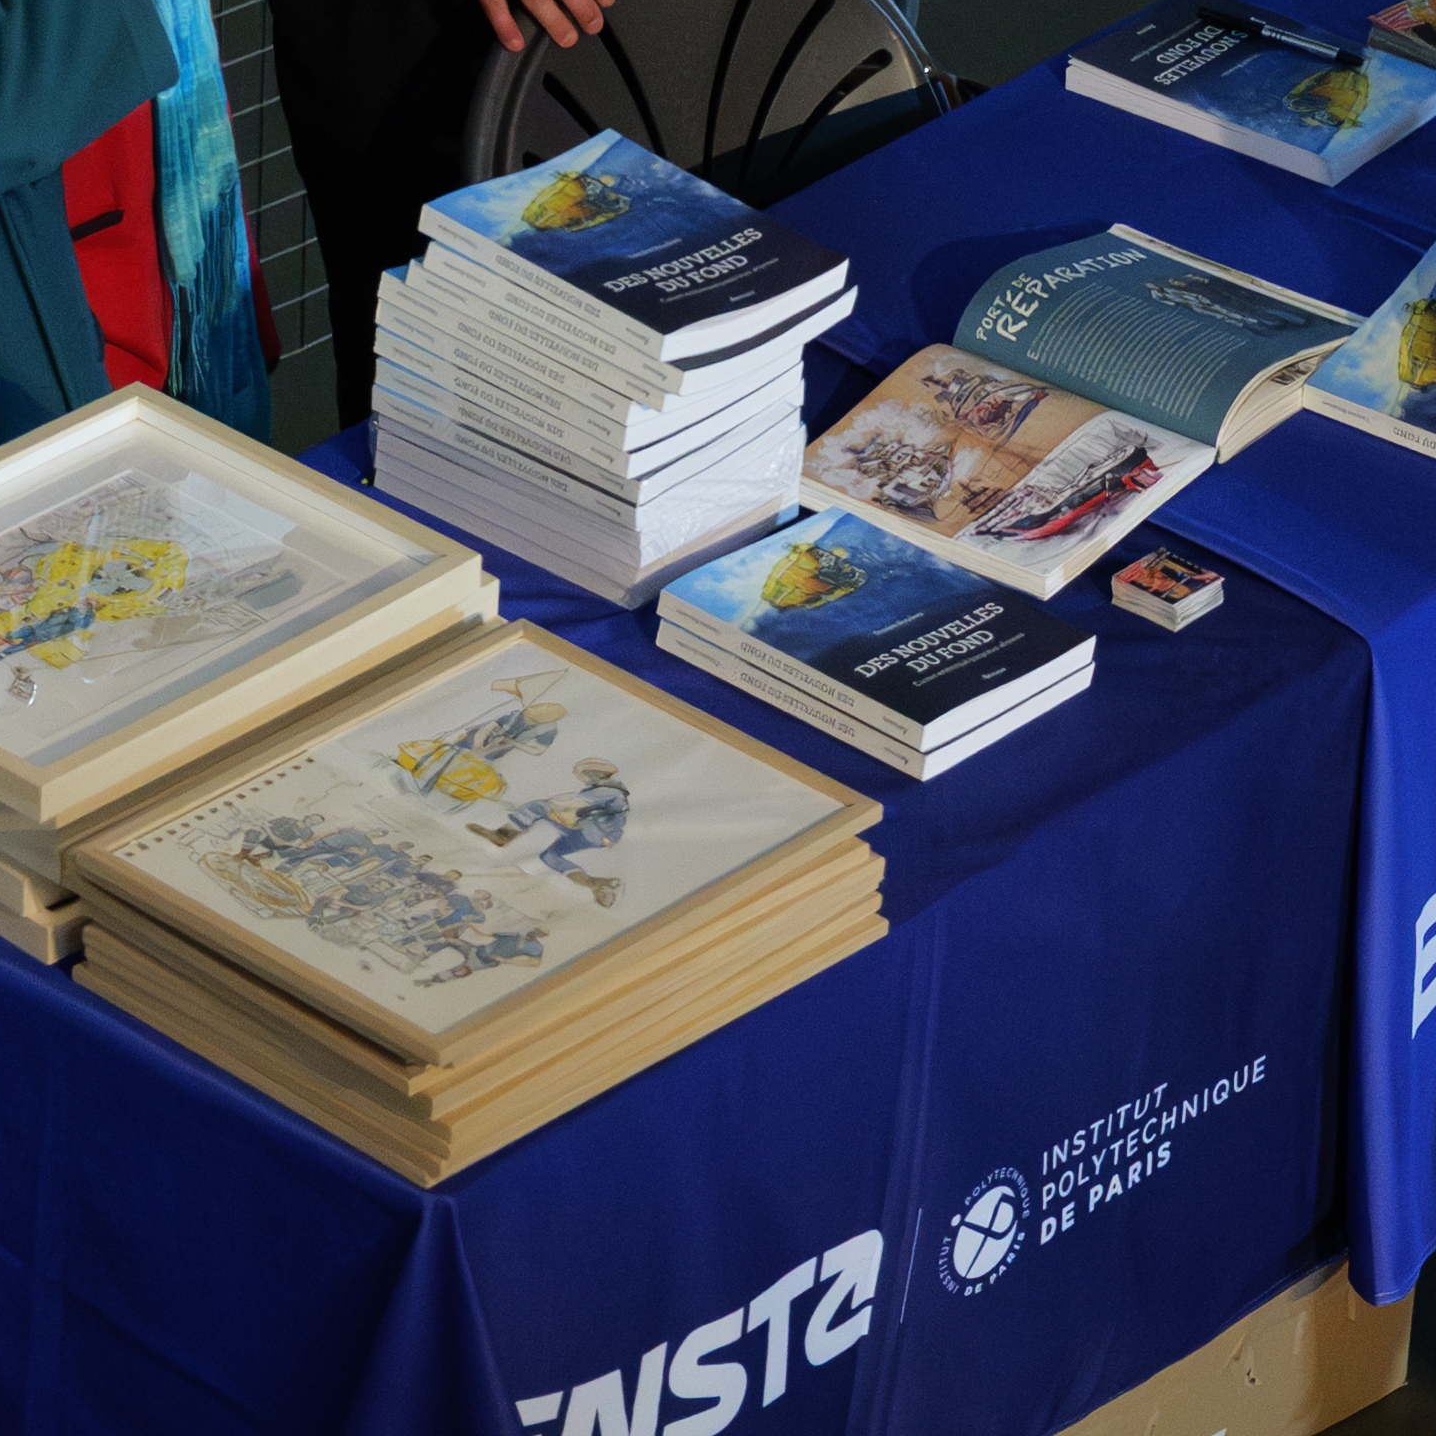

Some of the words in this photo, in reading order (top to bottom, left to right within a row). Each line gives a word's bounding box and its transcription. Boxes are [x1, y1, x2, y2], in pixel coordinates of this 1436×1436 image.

[1153, 35, 1240, 85] NOUVELLES
[1156, 37, 1203, 64] FOND
[1194, 25, 1225, 42] DU
[603, 273, 648, 293] DES
[643, 227, 763, 280] NOUVELLES
[655, 276, 690, 293] DU
[686, 255, 749, 283] FOND
[975, 295, 1006, 342] PORT
[1011, 273, 1032, 288] DE
[1421, 437, 1436, 450] DU
[854, 653, 899, 677] DES
[891, 602, 1004, 658] NOUVELLES
[906, 653, 941, 672] DU
[935, 630, 994, 659] FOND
[1042, 1082, 1168, 1176] INSTITUT
[1042, 1054, 1267, 1211] POLYTECHNIQUE
[964, 1166, 1032, 1220] POLYTECHNIQUE
[1040, 1201, 1076, 1246] DE
[1088, 1141, 1172, 1213] PARIS
[938, 1236, 960, 1295] INSTITUT
[989, 1231, 1026, 1285] PARIS
[963, 1281, 985, 1297] DE
